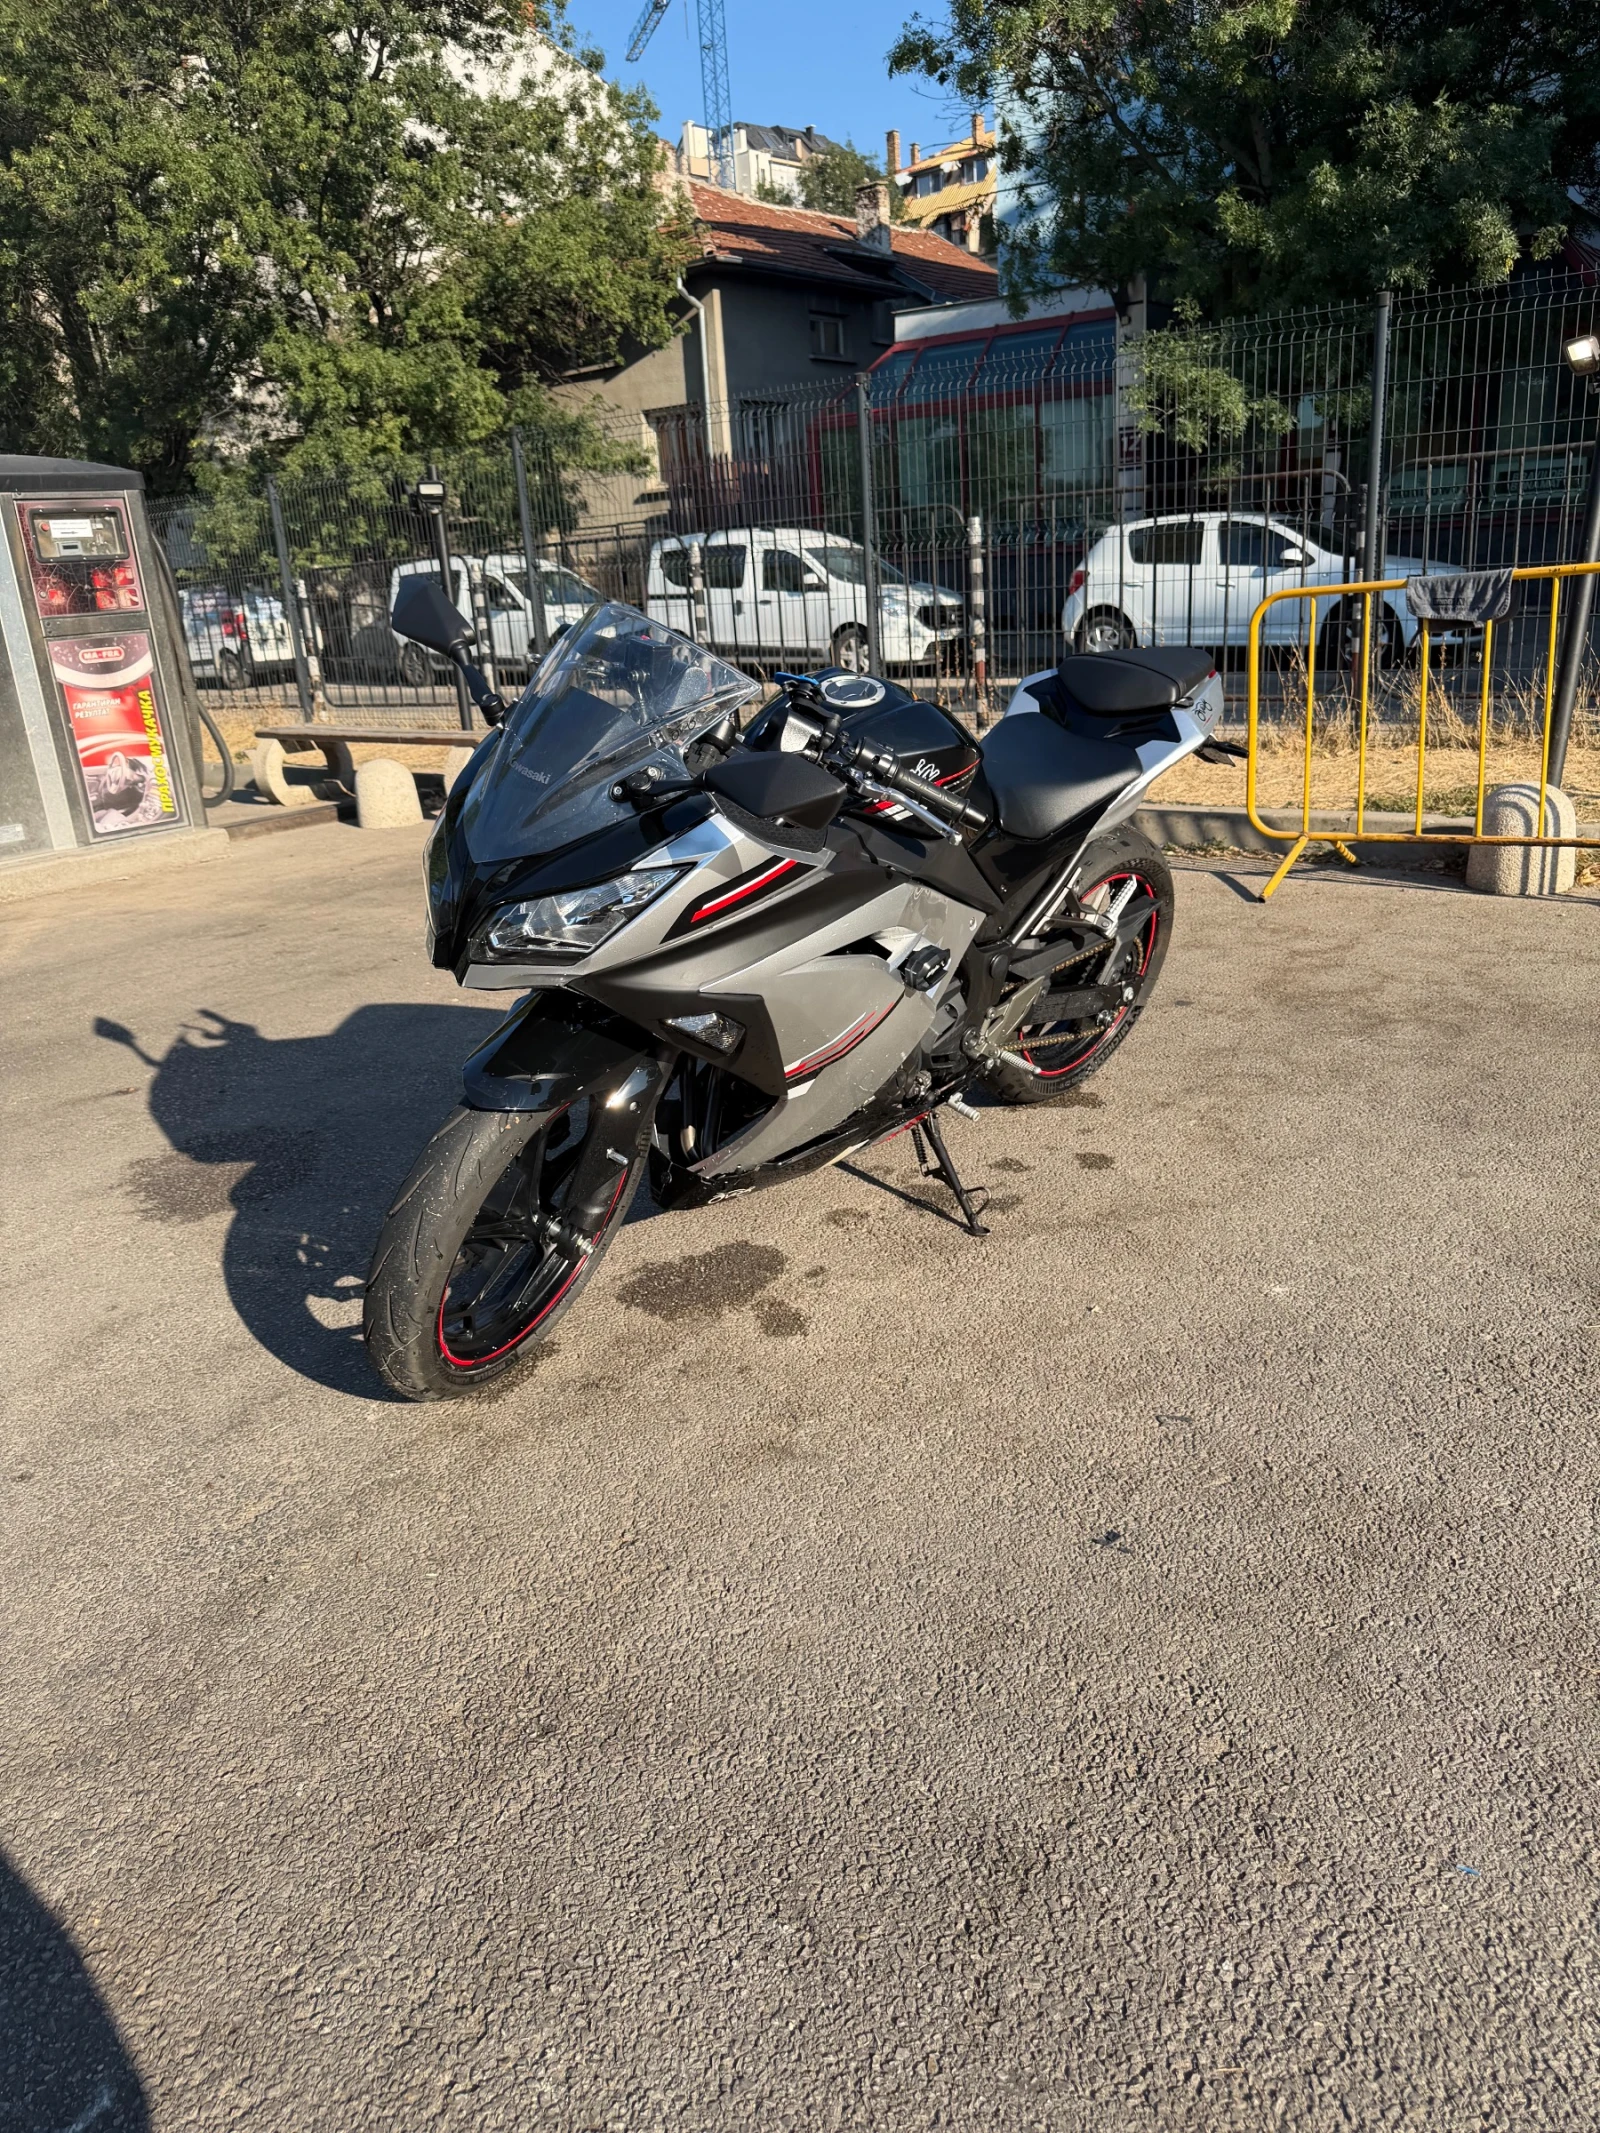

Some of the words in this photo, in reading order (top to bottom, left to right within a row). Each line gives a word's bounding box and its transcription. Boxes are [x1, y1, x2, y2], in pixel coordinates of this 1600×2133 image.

[1510, 478, 1562, 492] BNAMAT
[73, 698, 121, 710] ГАРАНТИРАН
[138, 690, 175, 812] ПРАХОСМУКАЧКА
